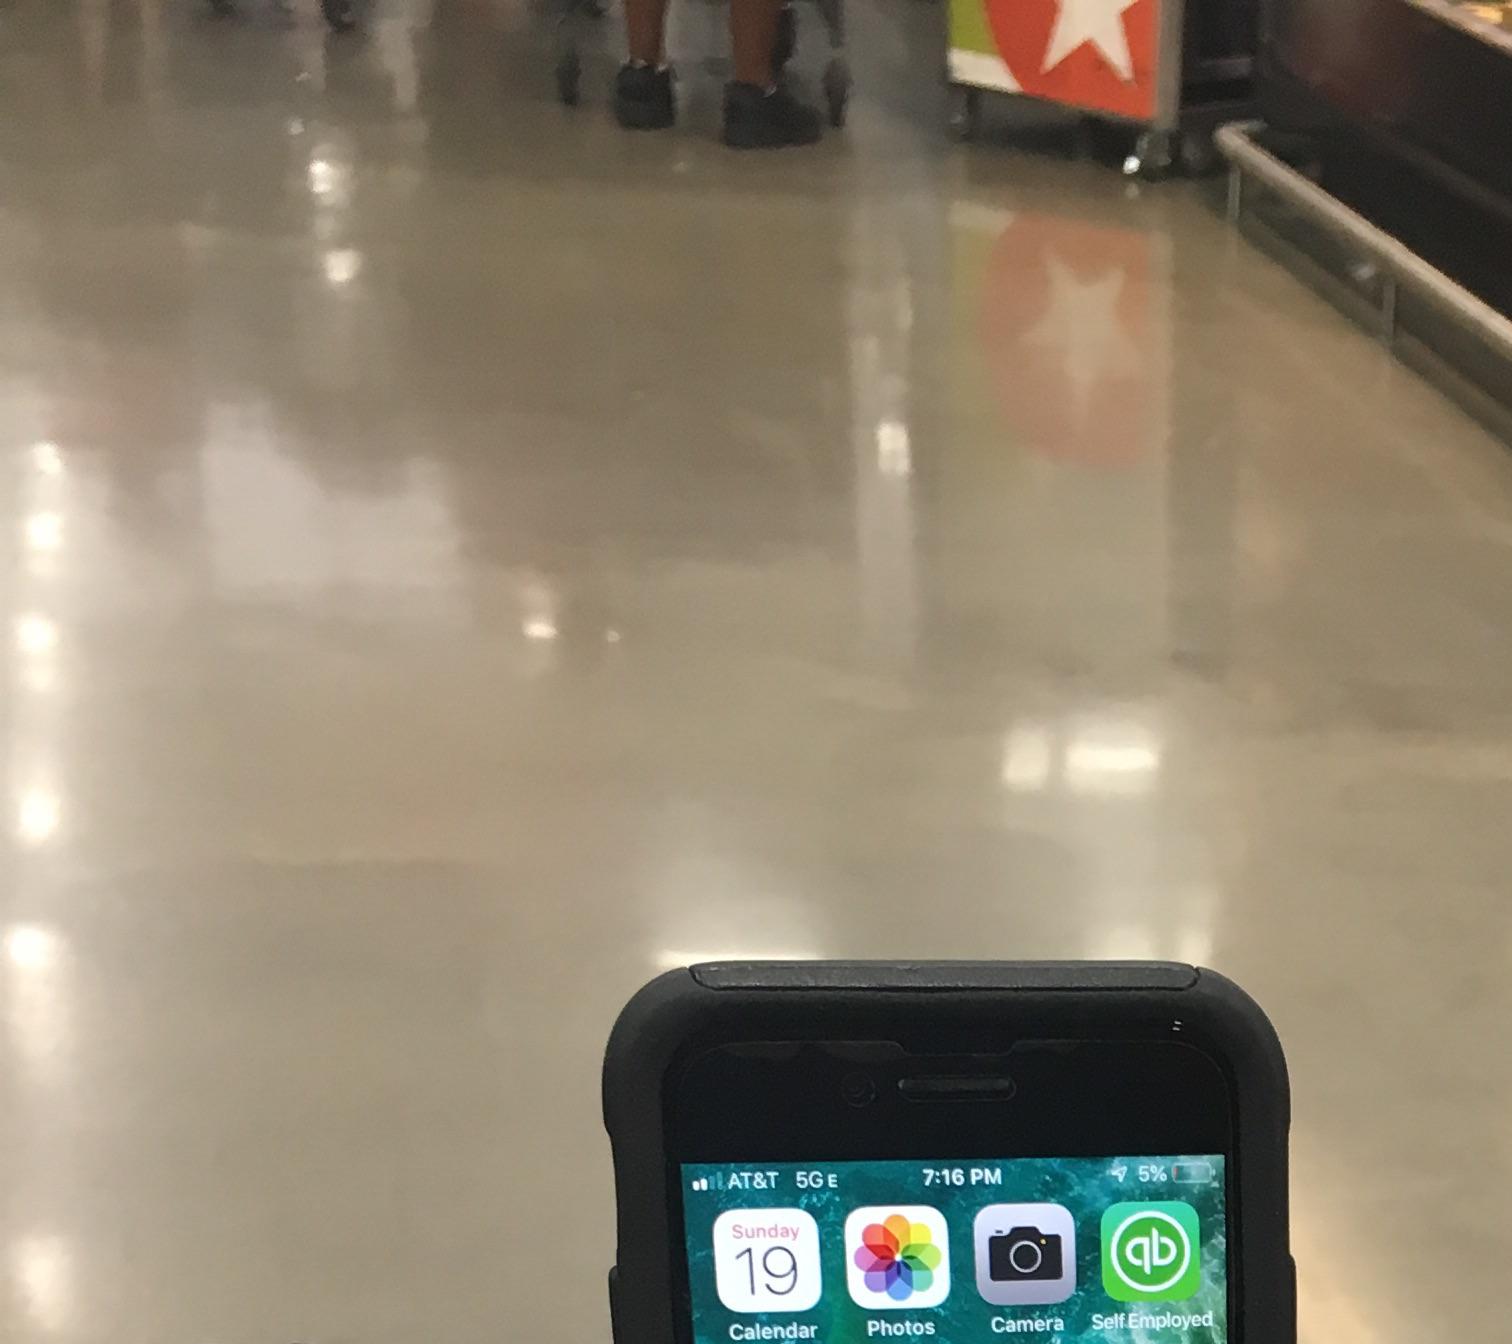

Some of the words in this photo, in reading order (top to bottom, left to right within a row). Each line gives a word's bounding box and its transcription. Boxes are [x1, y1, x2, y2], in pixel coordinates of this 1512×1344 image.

[727, 1171, 780, 1190] AT&T
[922, 1168, 965, 1187] 7:16
[970, 1167, 1003, 1186] PM
[1138, 1164, 1168, 1183] 5%
[731, 1223, 800, 1241] Sunday
[734, 1245, 799, 1296] 19
[728, 1321, 818, 1341] Calendar
[867, 1318, 936, 1337] Photos
[990, 1315, 1065, 1334] Camera
